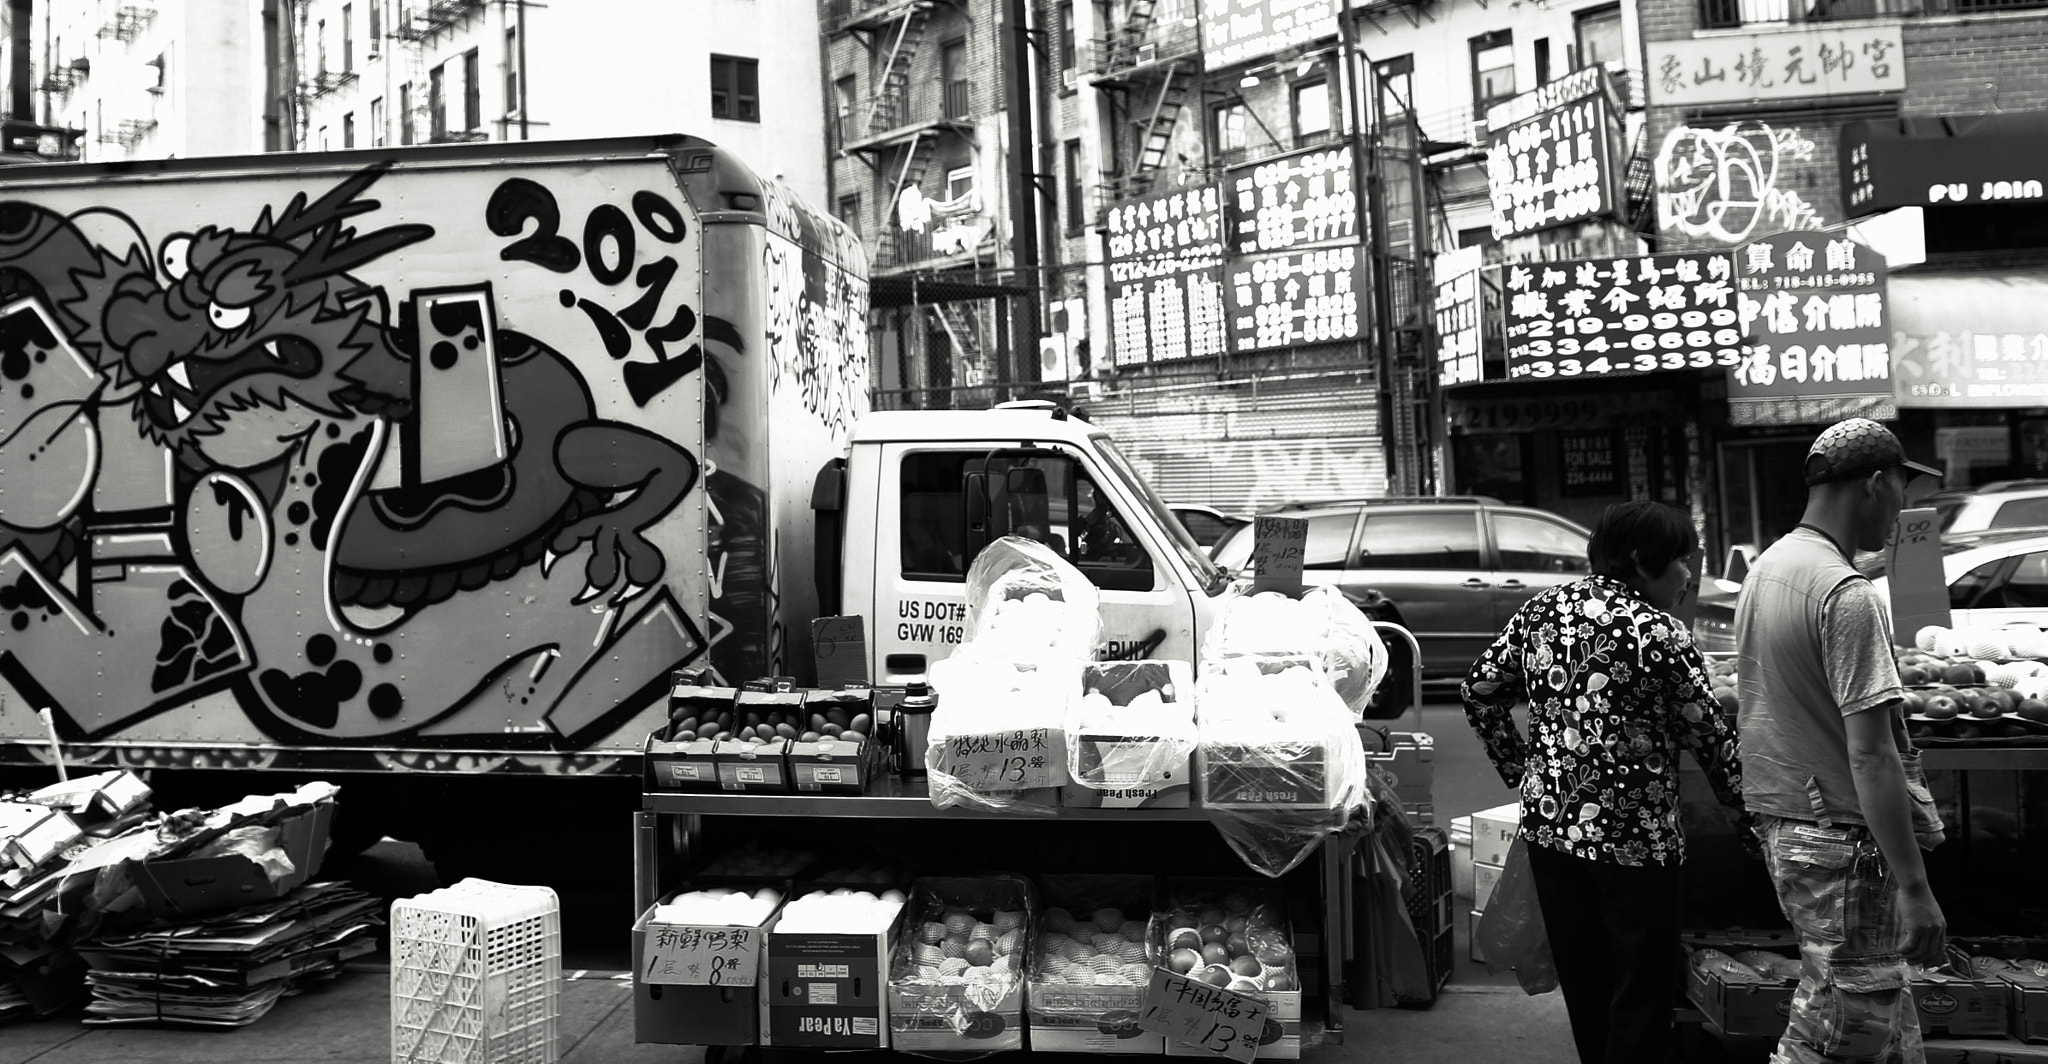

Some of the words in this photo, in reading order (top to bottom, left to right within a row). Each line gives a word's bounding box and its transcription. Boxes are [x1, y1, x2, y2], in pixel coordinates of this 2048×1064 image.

[1929, 183, 1968, 203] PU
[1528, 308, 1737, 338] 219-9999
[1529, 328, 1740, 357] 334-6666
[1530, 348, 1742, 378] 334-3333
[899, 600, 919, 618] US
[924, 602, 966, 622] DOT#
[898, 623, 935, 642] GVW
[799, 1017, 832, 1036] Pear
[834, 1017, 851, 1036] Ya
